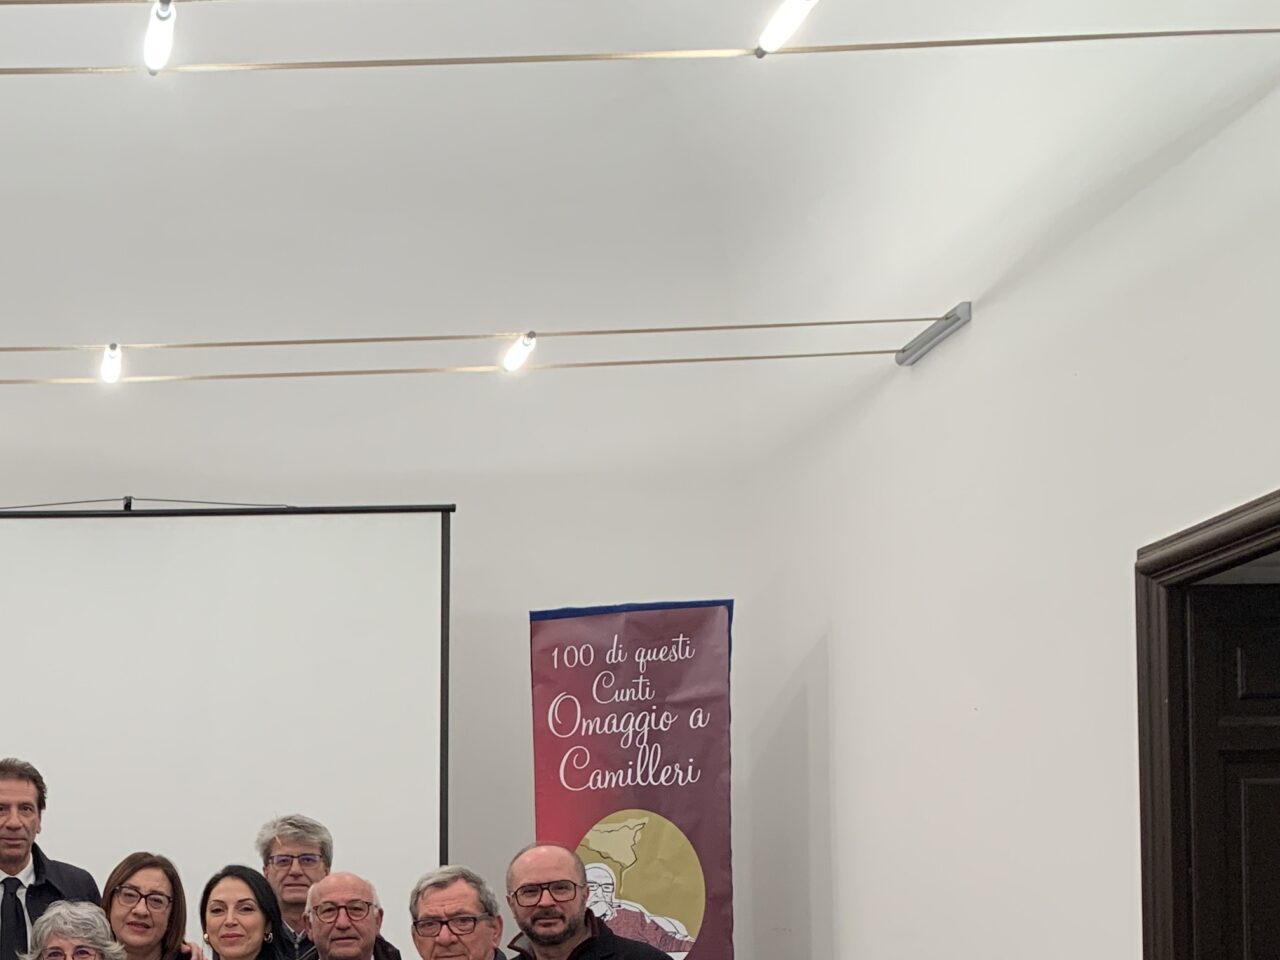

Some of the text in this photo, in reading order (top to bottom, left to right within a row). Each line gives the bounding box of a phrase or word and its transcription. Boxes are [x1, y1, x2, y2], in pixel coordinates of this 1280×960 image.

[551, 633, 696, 673] 100 di questi
[592, 670, 656, 704] Cunti
[547, 691, 710, 749] Omaggio a
[559, 743, 702, 792] Camilleri
